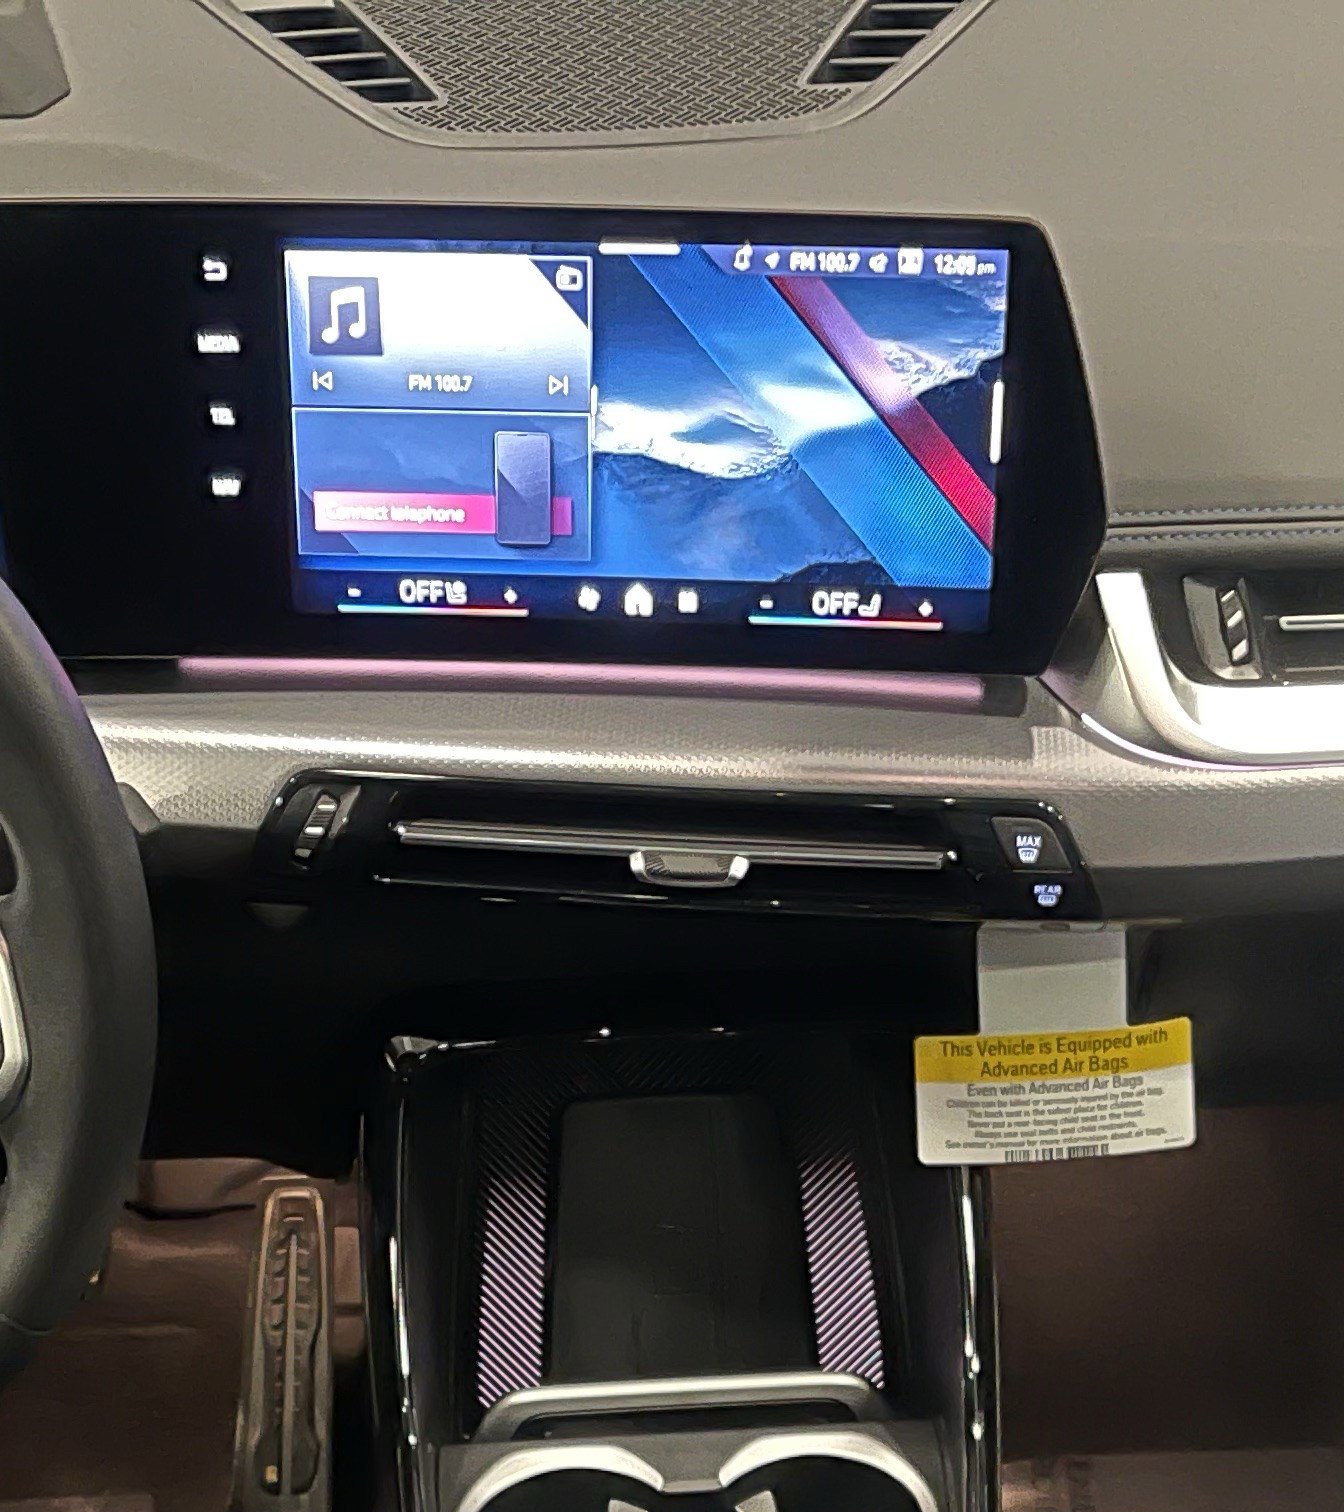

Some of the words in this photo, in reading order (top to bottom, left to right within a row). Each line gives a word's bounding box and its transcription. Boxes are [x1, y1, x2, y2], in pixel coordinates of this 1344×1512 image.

[790, 251, 814, 272] FM
[818, 251, 860, 273] 100.7
[408, 374, 432, 392] FM
[399, 578, 444, 604] OFF
[812, 590, 860, 616] OFF
[1016, 835, 1042, 848] MAX
[939, 1040, 974, 1058] This
[976, 1038, 1036, 1058] Vehicle
[1038, 1038, 1053, 1055] is
[1056, 1032, 1133, 1056] Equipped
[1135, 1026, 1169, 1047] with
[980, 1058, 1058, 1078] Advanced
[1062, 1056, 1086, 1074] Air
[1088, 1054, 1130, 1075] Bags
[967, 1083, 998, 1098] Even
[999, 1083, 1027, 1097] with
[1029, 1078, 1090, 1095] Advanced
[1092, 1076, 1110, 1090] Air
[1112, 1074, 1144, 1091] Bags
